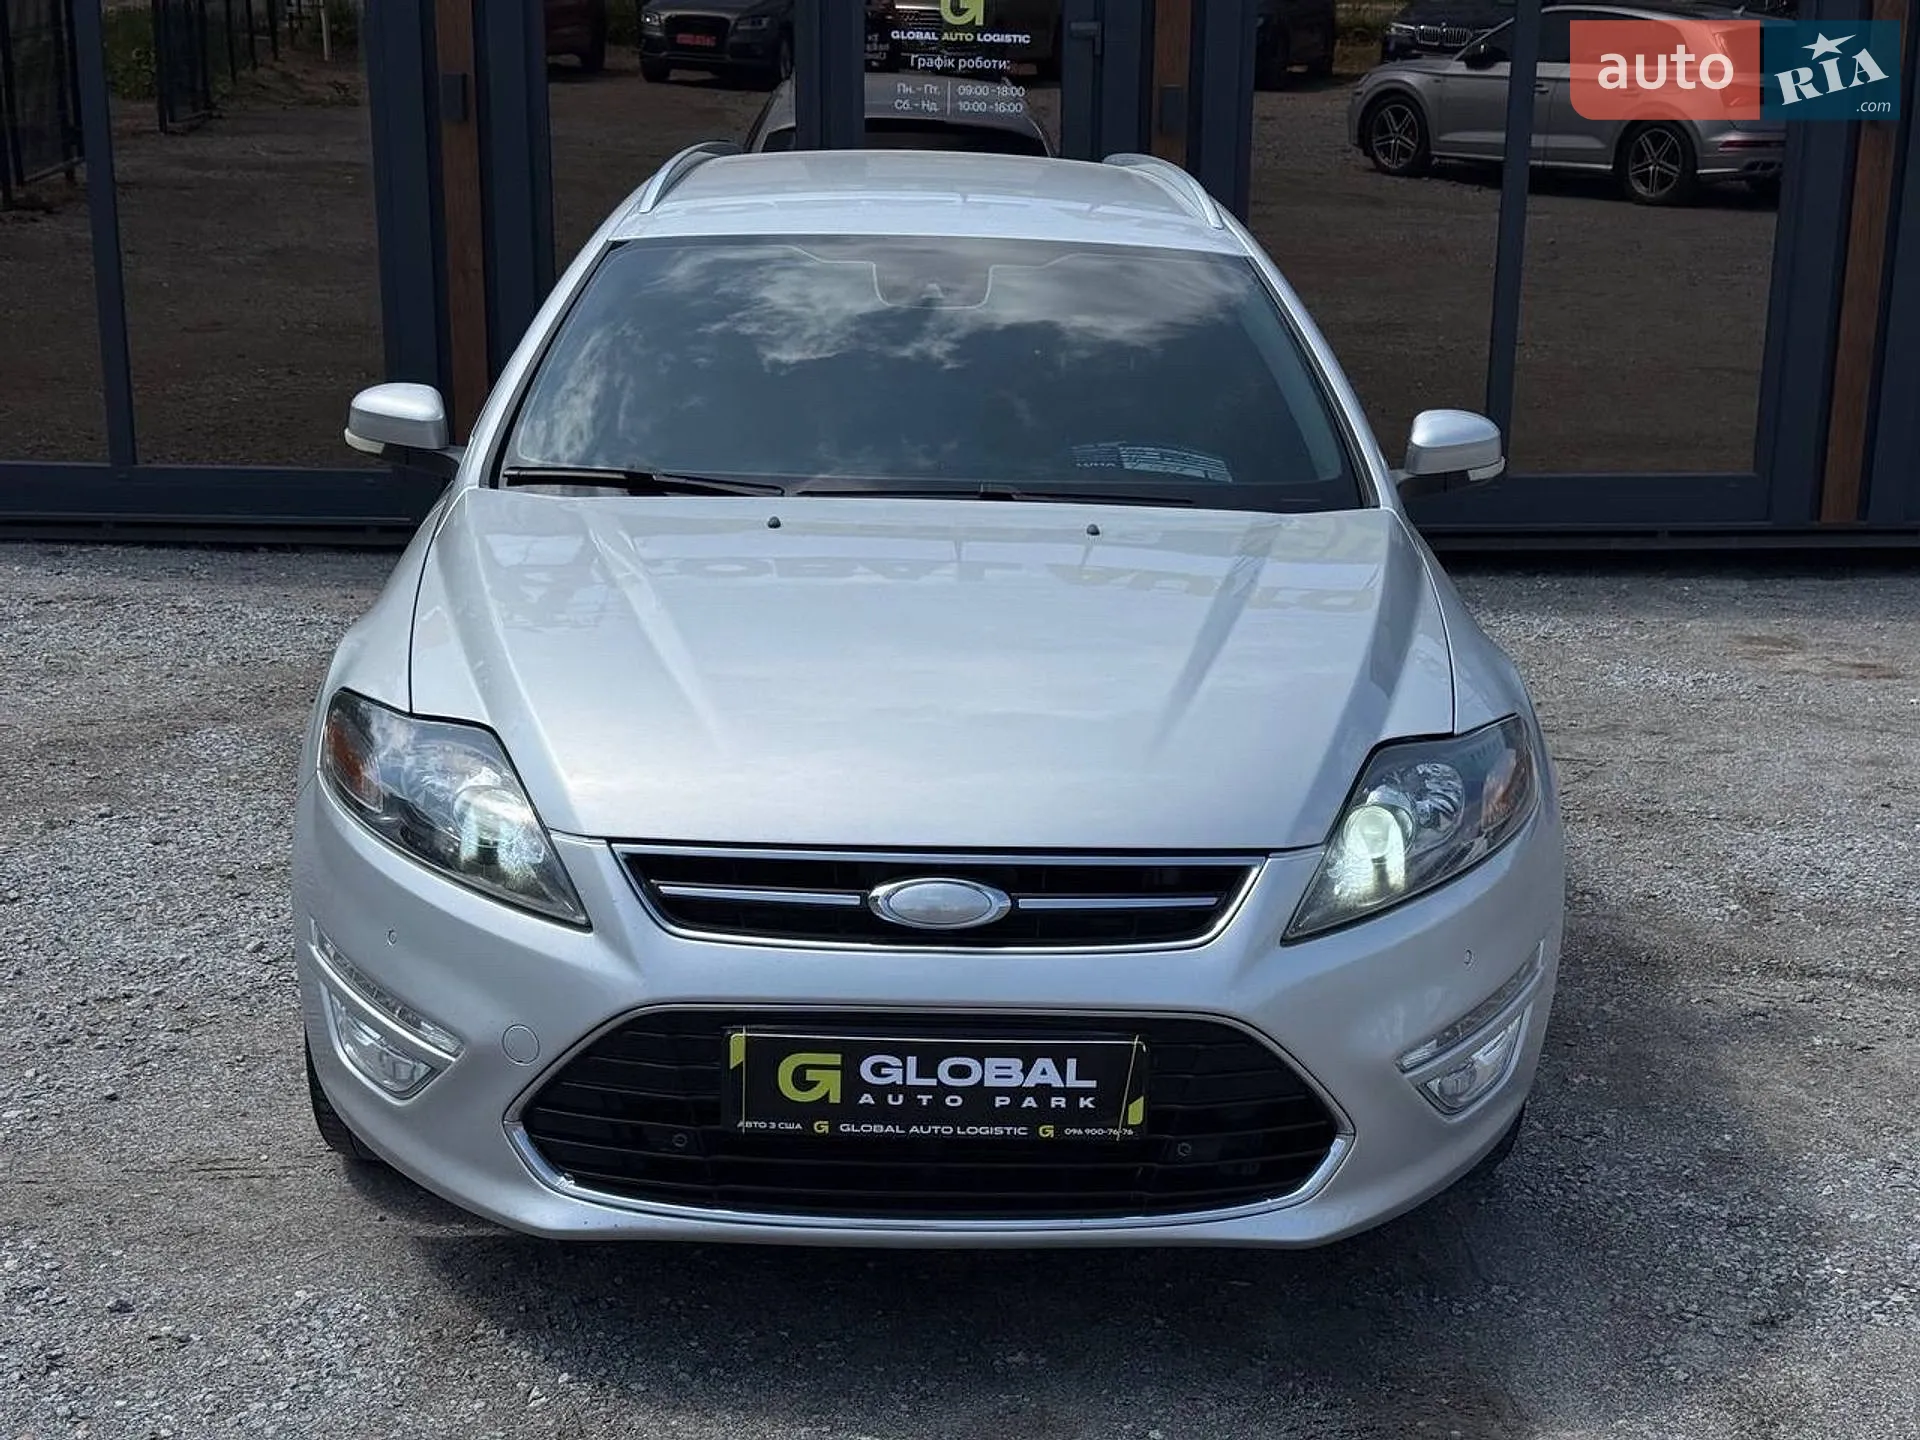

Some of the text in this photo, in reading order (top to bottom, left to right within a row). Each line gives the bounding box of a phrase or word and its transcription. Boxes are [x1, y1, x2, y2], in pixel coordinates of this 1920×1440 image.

[891, 30, 1031, 44] GLOBAL AUTO LOGISTIC
[910, 54, 1011, 70] Графік роботи:
[958, 85, 989, 96] 09:00
[958, 101, 987, 113] 10:00
[778, 1053, 1097, 1104] G GLOBAL
[858, 1093, 1096, 1108] AUTO PARK
[778, 1121, 803, 1130] США
[839, 1123, 905, 1133] GLOBAL
[908, 1125, 954, 1134] AUTO
[956, 1125, 1028, 1136] LOGISTIC
